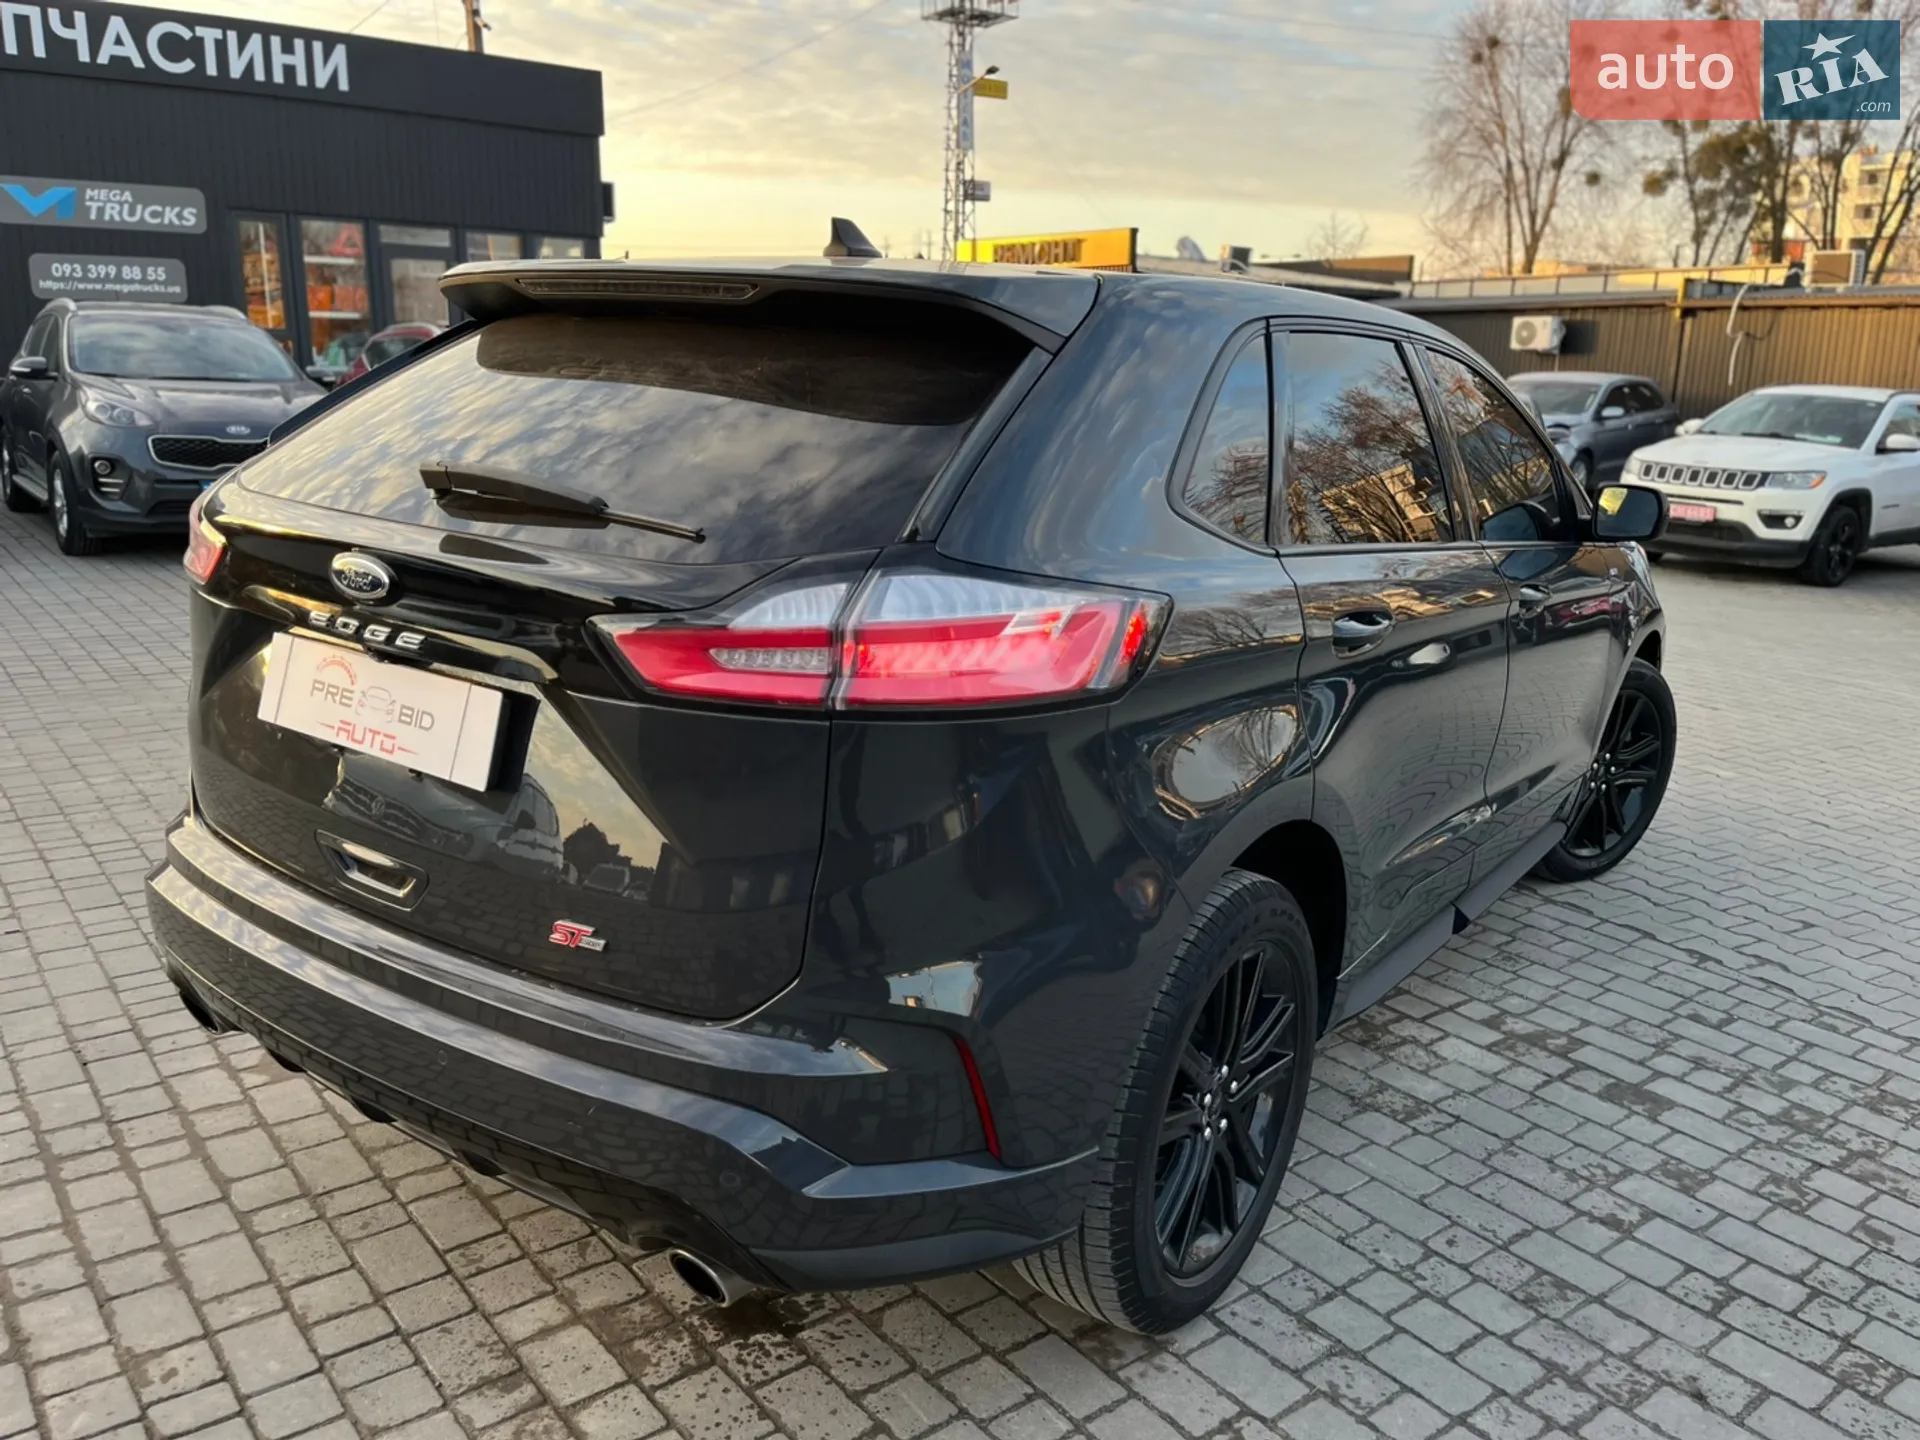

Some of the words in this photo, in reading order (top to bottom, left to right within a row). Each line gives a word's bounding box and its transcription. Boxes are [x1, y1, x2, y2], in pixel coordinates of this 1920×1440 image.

[0, 1, 349, 92] ПЧАСТИНИ
[85, 188, 133, 203] MEGA
[85, 201, 198, 227] TRUCKS
[51, 263, 83, 278] 093
[87, 265, 117, 280] 399
[122, 265, 142, 280] 88
[147, 267, 166, 281] 55
[341, 566, 374, 591] Ford
[309, 610, 427, 650] EDGE
[310, 679, 355, 709] PRE
[398, 704, 436, 732] BID
[336, 719, 397, 756] AUTO
